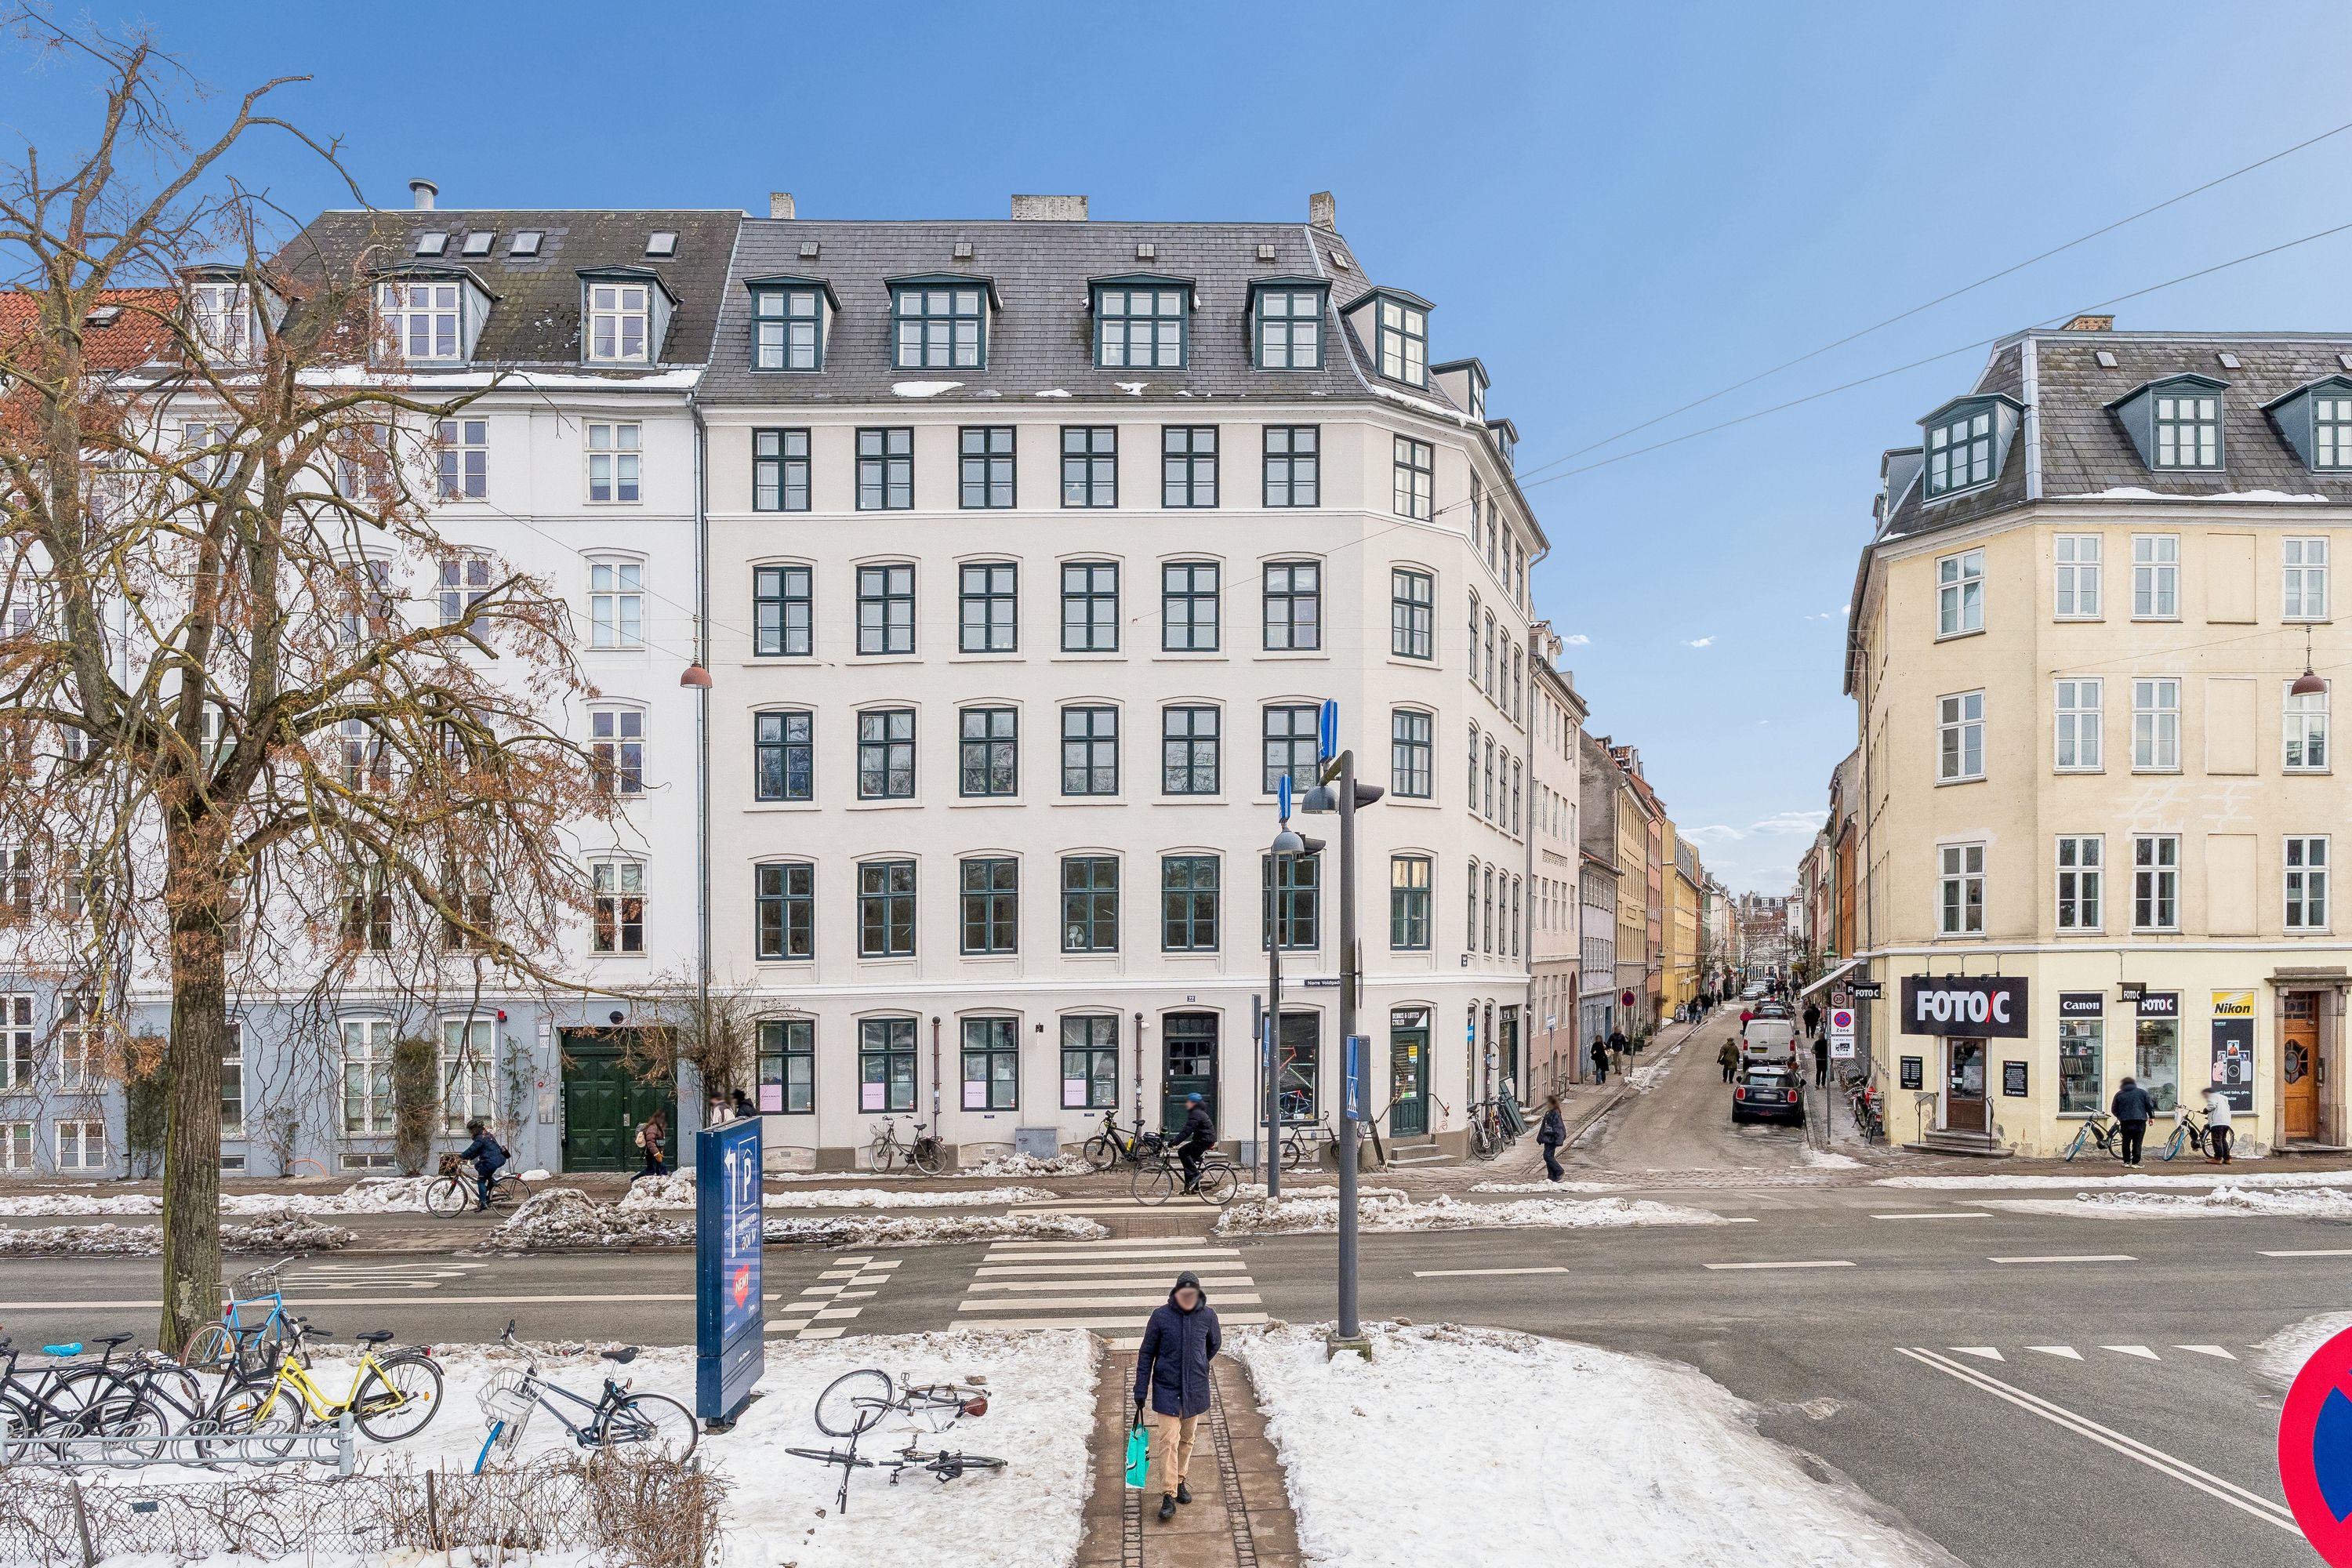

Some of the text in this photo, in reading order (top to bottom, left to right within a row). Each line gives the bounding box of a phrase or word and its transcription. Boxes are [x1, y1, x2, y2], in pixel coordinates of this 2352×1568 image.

[2123, 990, 2140, 1000] FOTO C
[2063, 1000, 2100, 1011] Canon
[2214, 1003, 2251, 1014] Nikon
[743, 1157, 751, 1203] P
